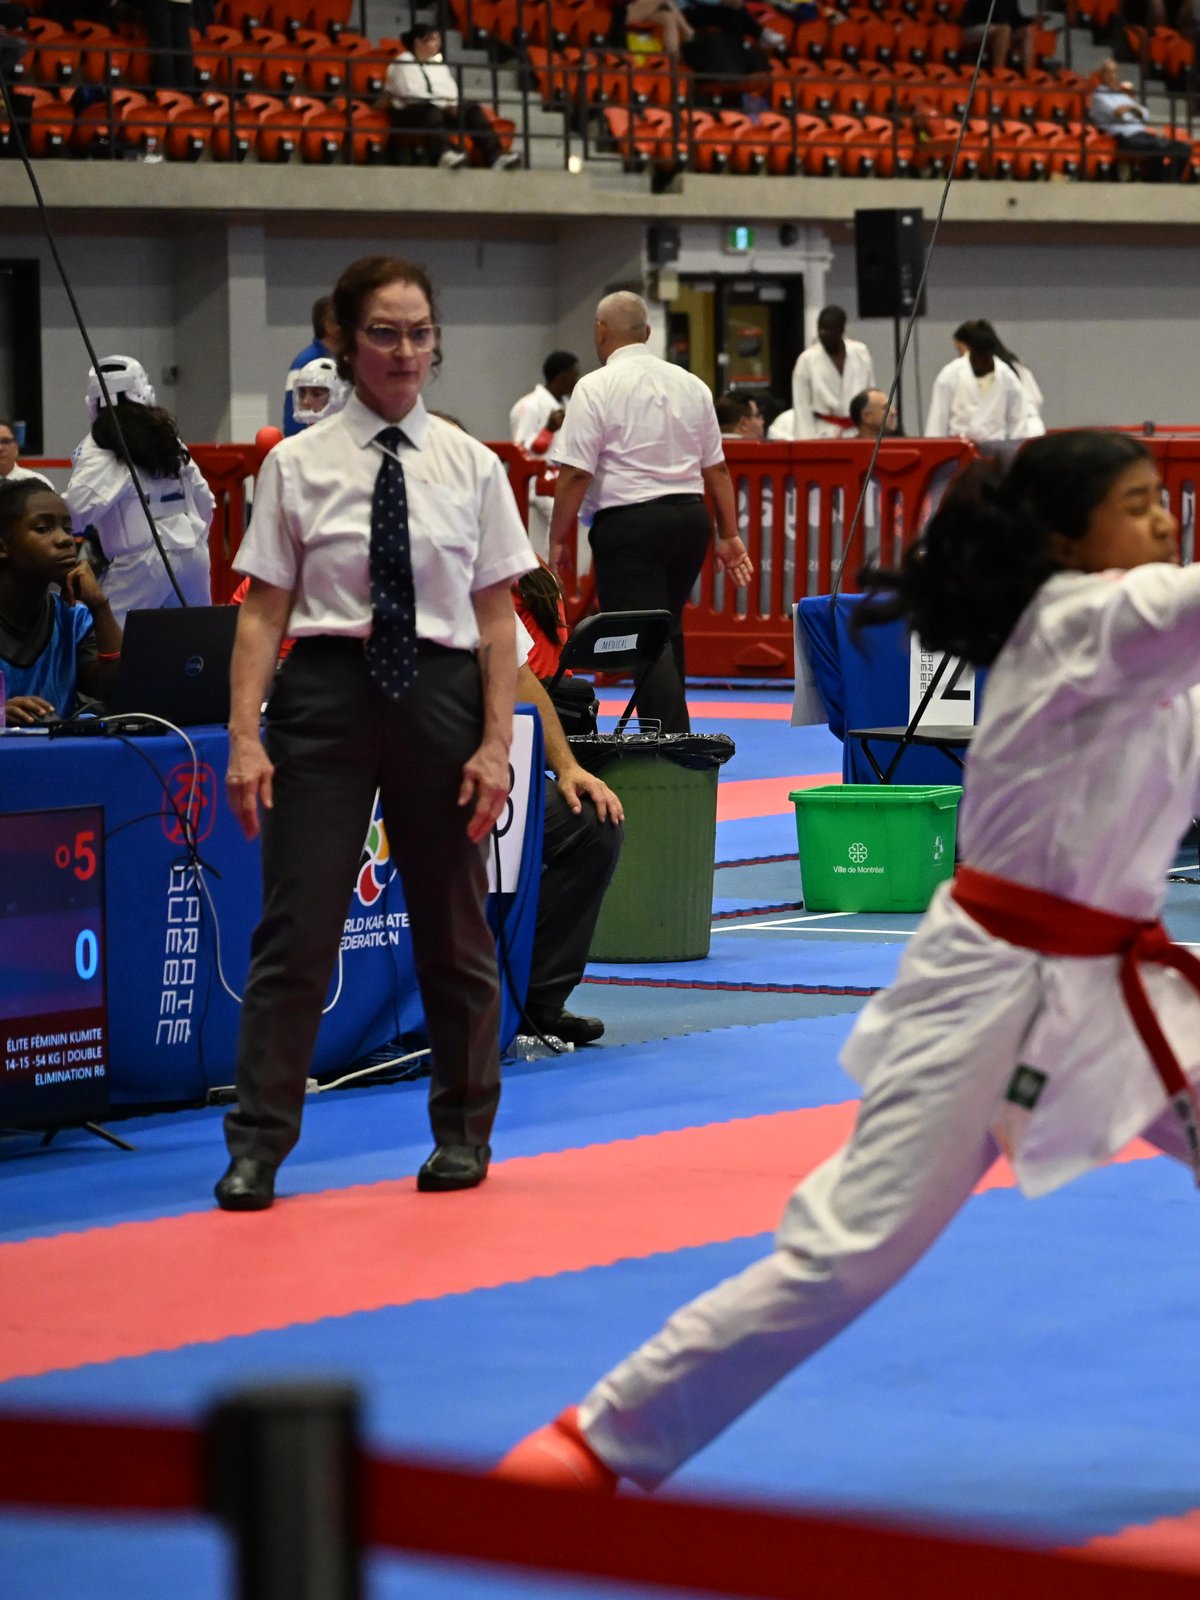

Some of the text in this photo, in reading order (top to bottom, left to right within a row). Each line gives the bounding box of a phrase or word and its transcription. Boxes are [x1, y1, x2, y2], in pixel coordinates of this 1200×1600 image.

[602, 639, 627, 649] MEDICAL
[73, 831, 96, 881] 5
[857, 866, 884, 874] Montréal
[344, 918, 364, 933] RLD
[340, 931, 399, 950] EDERATION
[75, 929, 98, 980] 0
[7, 1027, 102, 1053] ÉLITE FÉMININ KUMITE
[5, 1056, 29, 1072] 14-15
[48, 1052, 60, 1065] KG
[67, 1046, 102, 1062] DOUBLE
[35, 1064, 105, 1086] ELIMINATION R6
